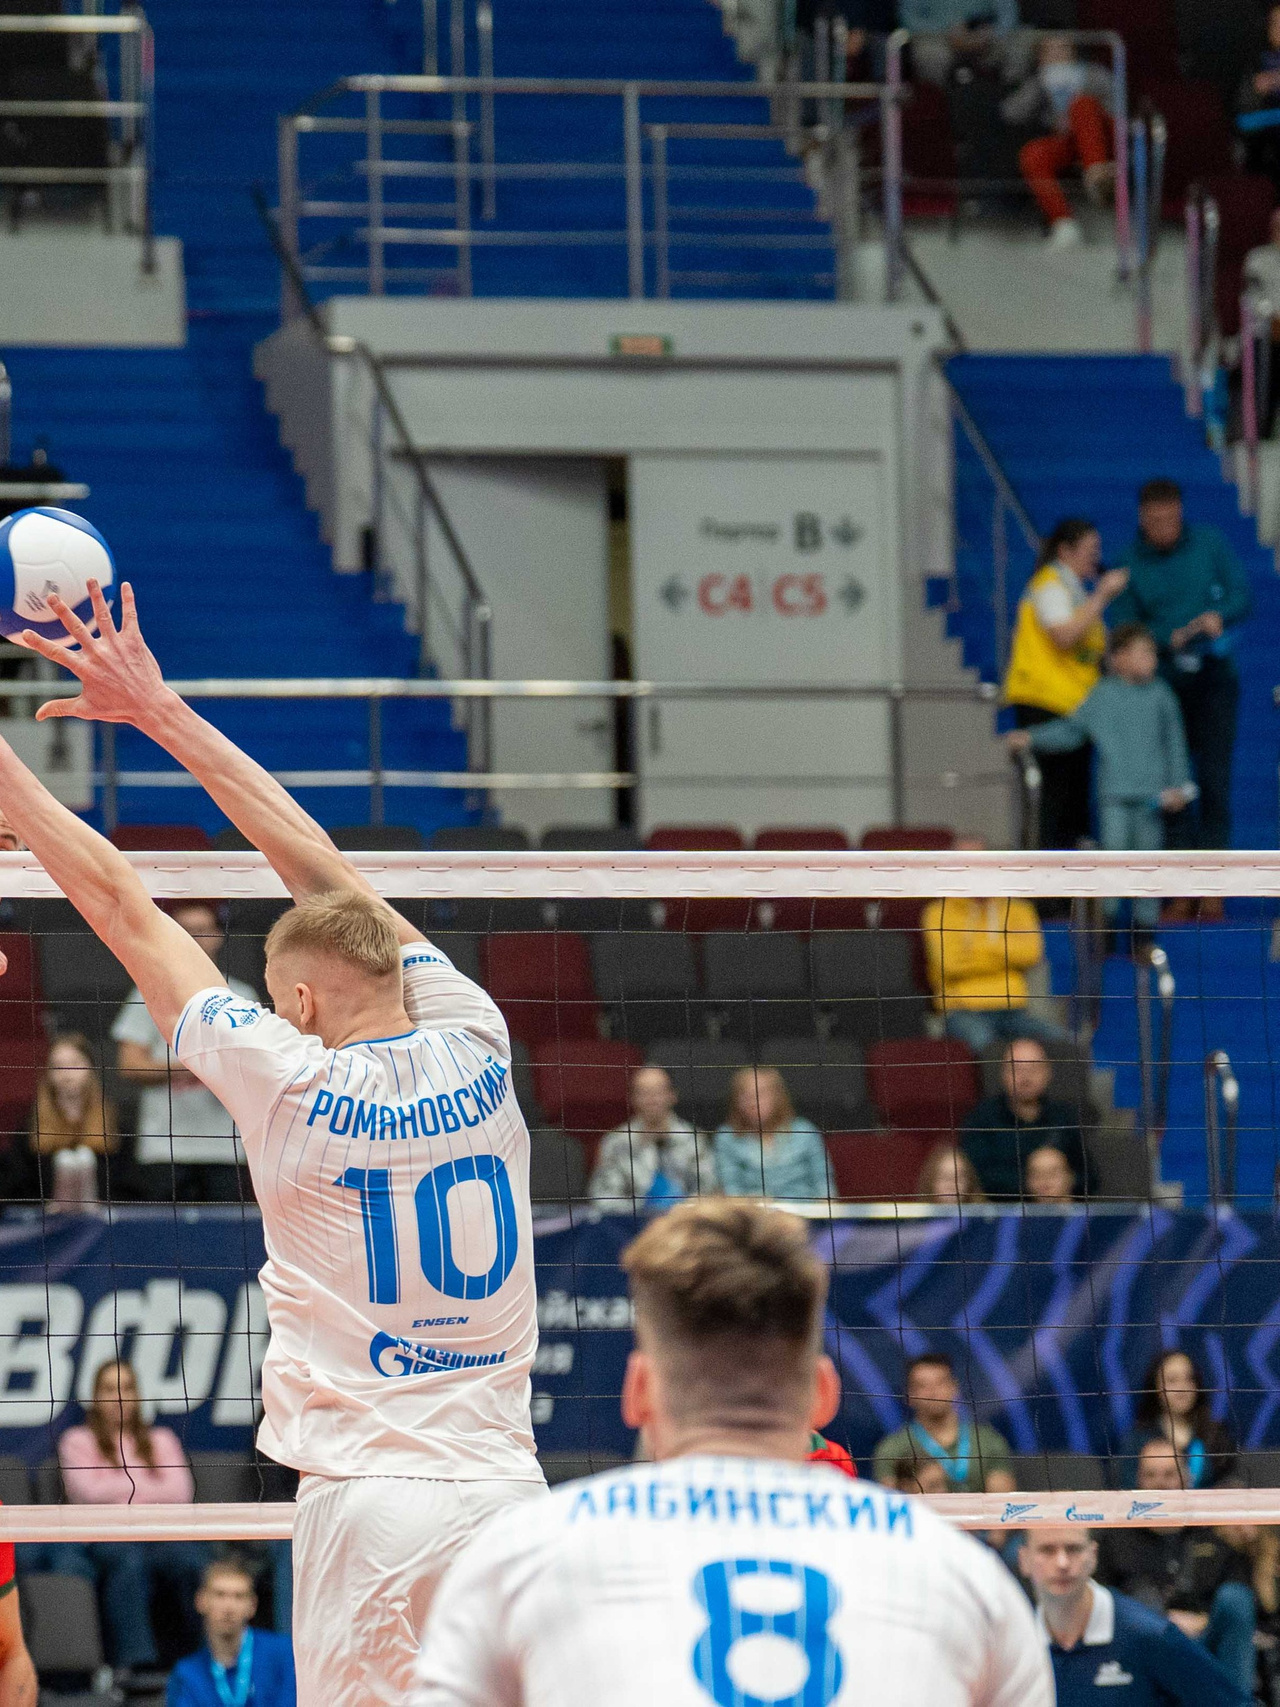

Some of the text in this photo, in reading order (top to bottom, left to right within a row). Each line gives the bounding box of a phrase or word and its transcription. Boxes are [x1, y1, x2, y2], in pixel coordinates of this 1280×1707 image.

[306, 1055, 508, 1141] РОМАНОВСКИЙ
[332, 1154, 518, 1304] 10
[412, 1317, 469, 1328] ENSEN
[691, 1558, 844, 1707] 8
